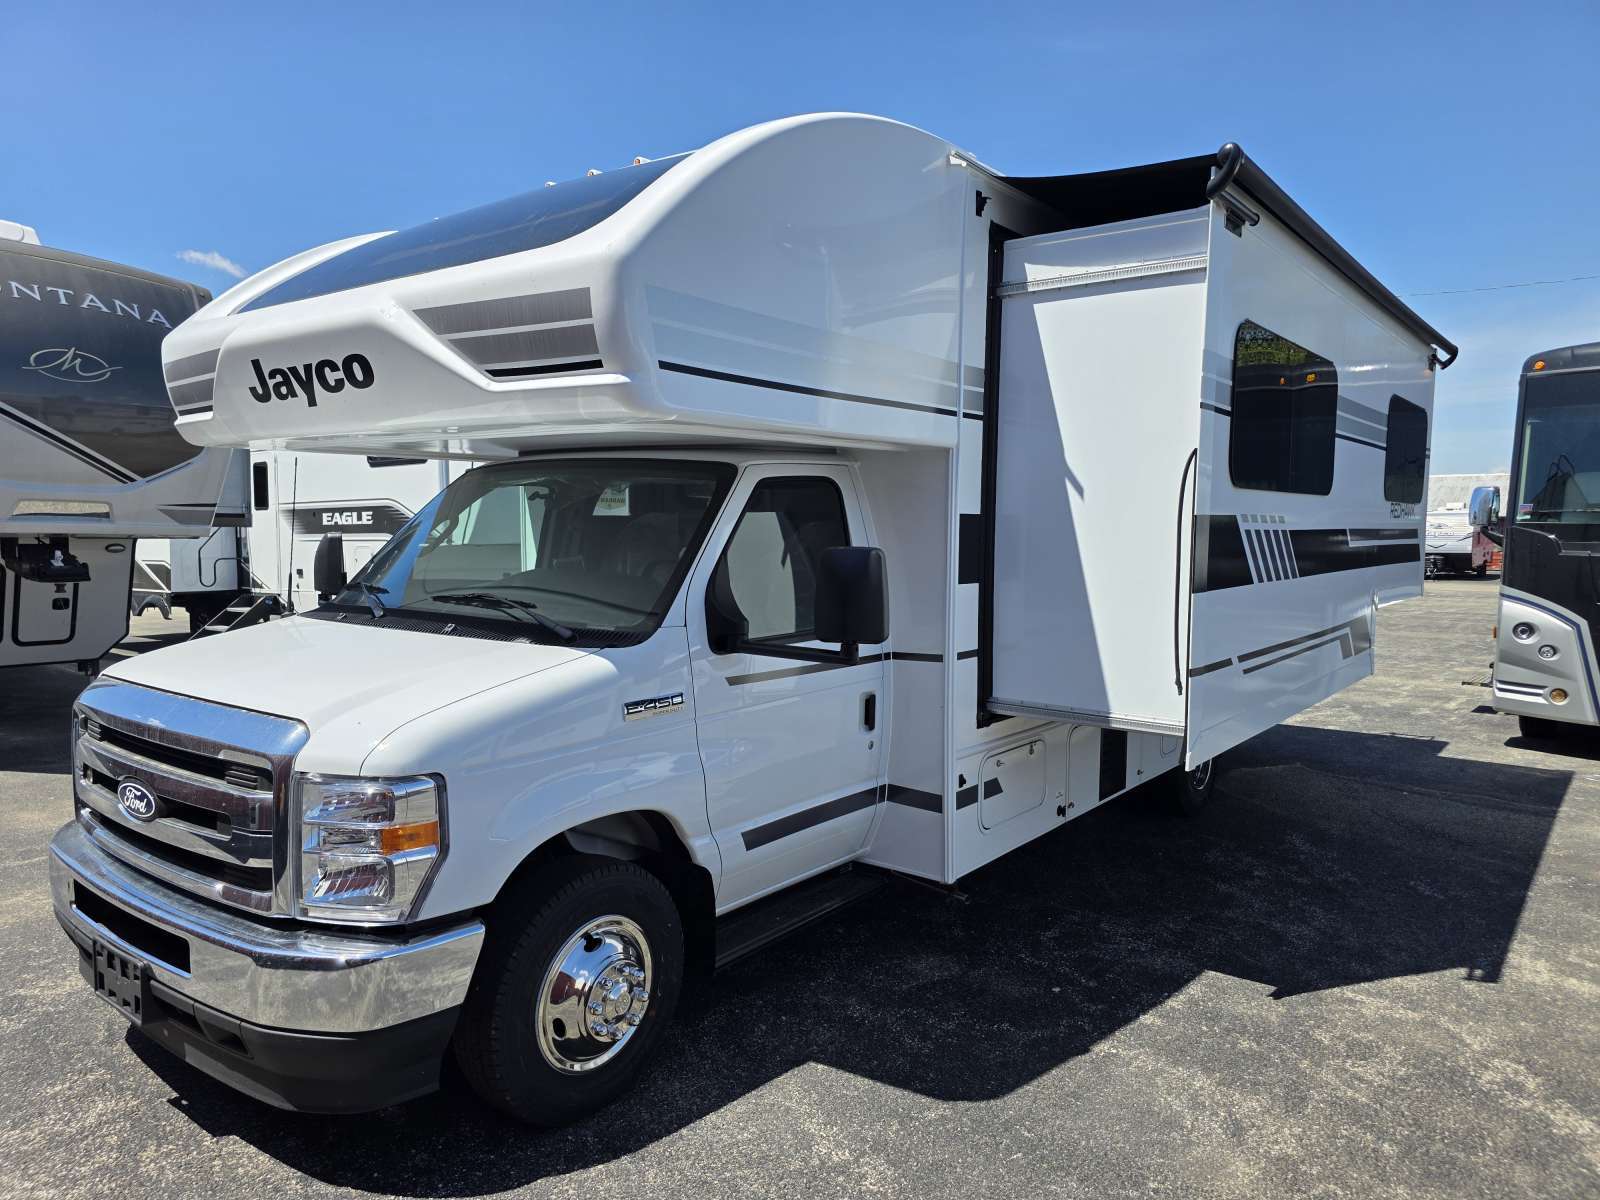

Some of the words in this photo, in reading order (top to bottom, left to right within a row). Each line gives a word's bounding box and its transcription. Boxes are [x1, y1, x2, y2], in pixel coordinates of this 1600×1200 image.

[0, 279, 173, 329] NTANA
[249, 353, 375, 407] Jayco
[322, 511, 373, 525] EAGLE
[124, 786, 147, 813] Ford
